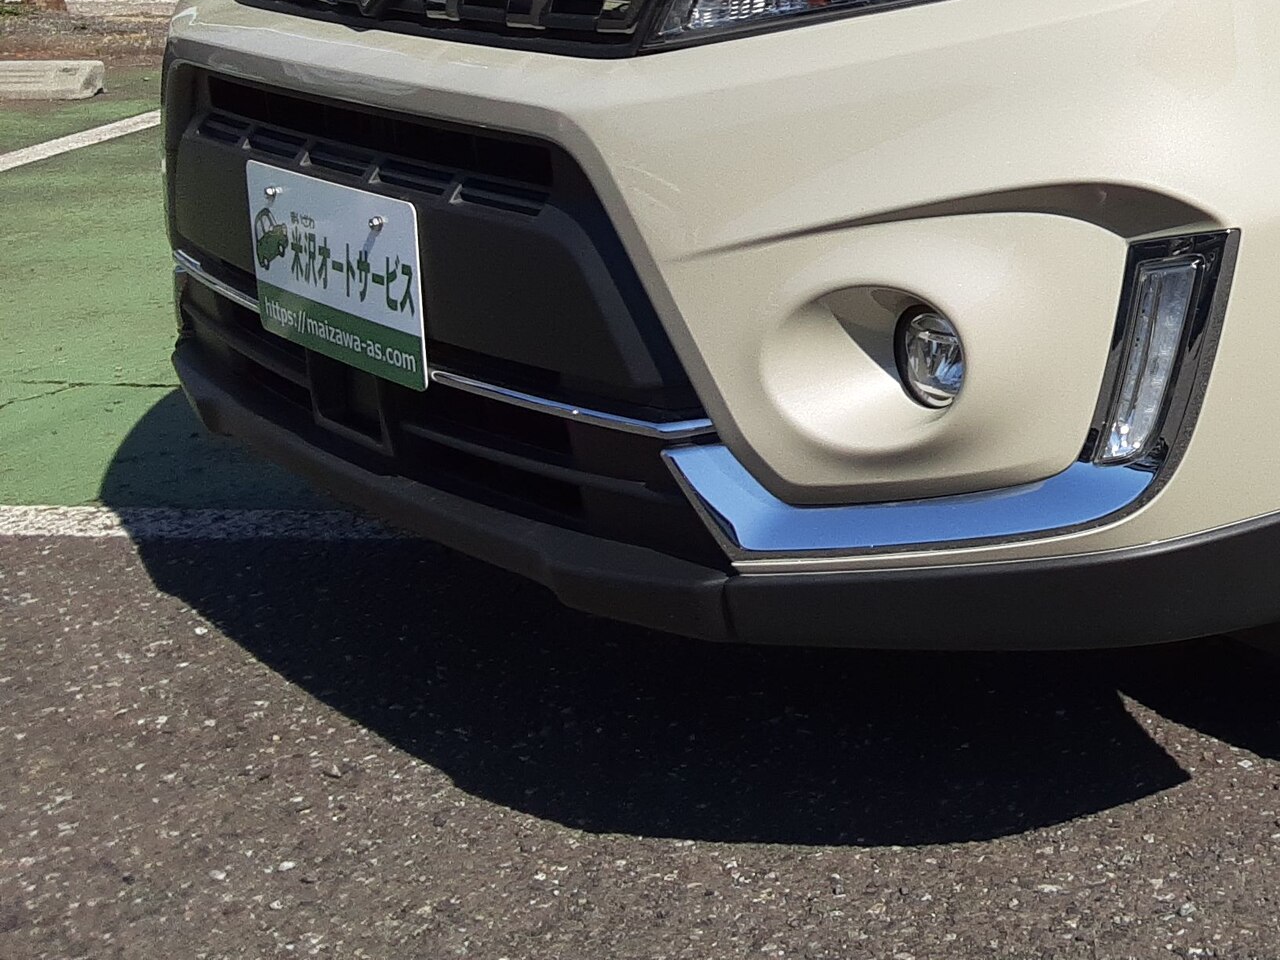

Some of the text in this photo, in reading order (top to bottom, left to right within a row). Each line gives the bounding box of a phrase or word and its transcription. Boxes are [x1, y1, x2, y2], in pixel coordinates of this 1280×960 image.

[290, 226, 415, 317] 米沢オートサービス
[264, 296, 417, 373] https://maizawa-as.com
